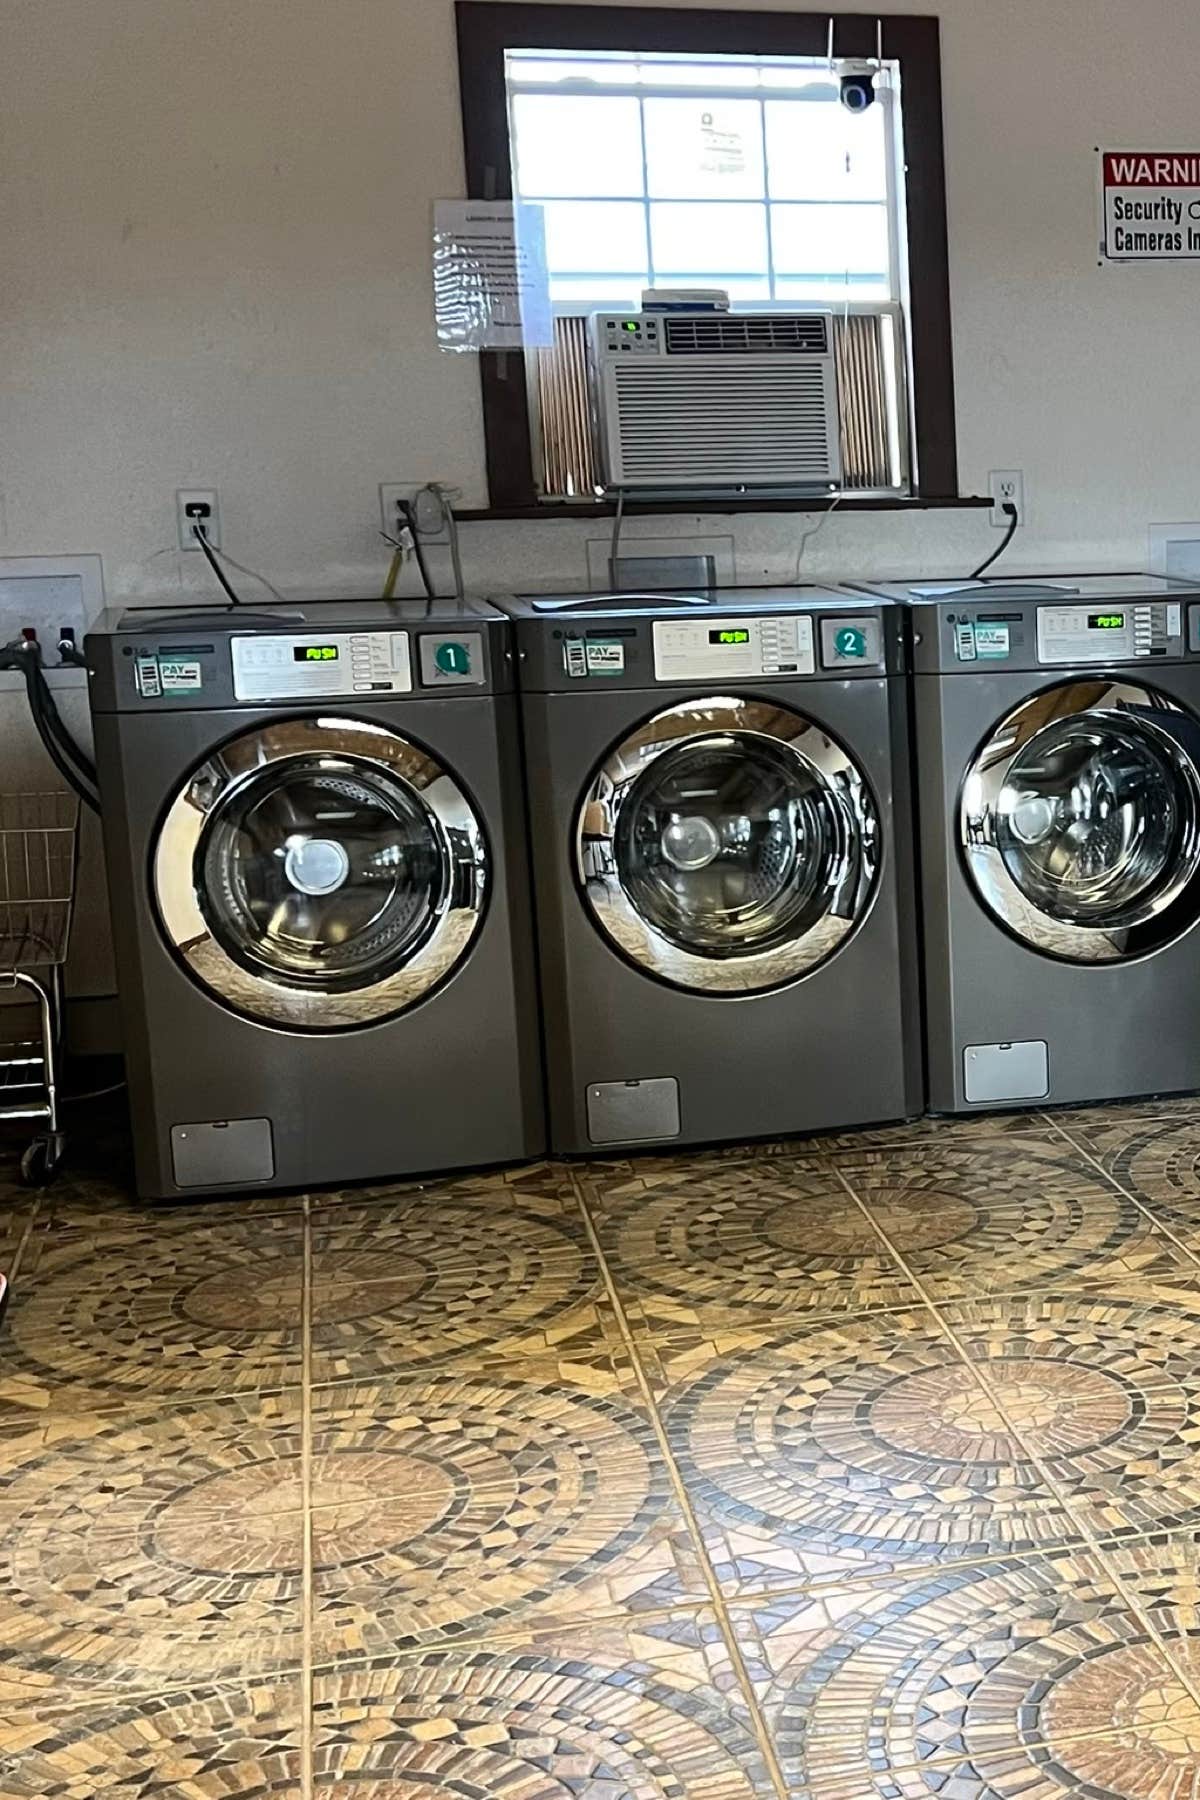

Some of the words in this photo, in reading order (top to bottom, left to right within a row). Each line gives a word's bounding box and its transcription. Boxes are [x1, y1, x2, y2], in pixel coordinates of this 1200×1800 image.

[1114, 196, 1183, 225] Security
[1115, 226, 1182, 251] Cameras
[843, 632, 857, 651] 2
[446, 647, 456, 667] 1
[162, 665, 184, 674] PAY
